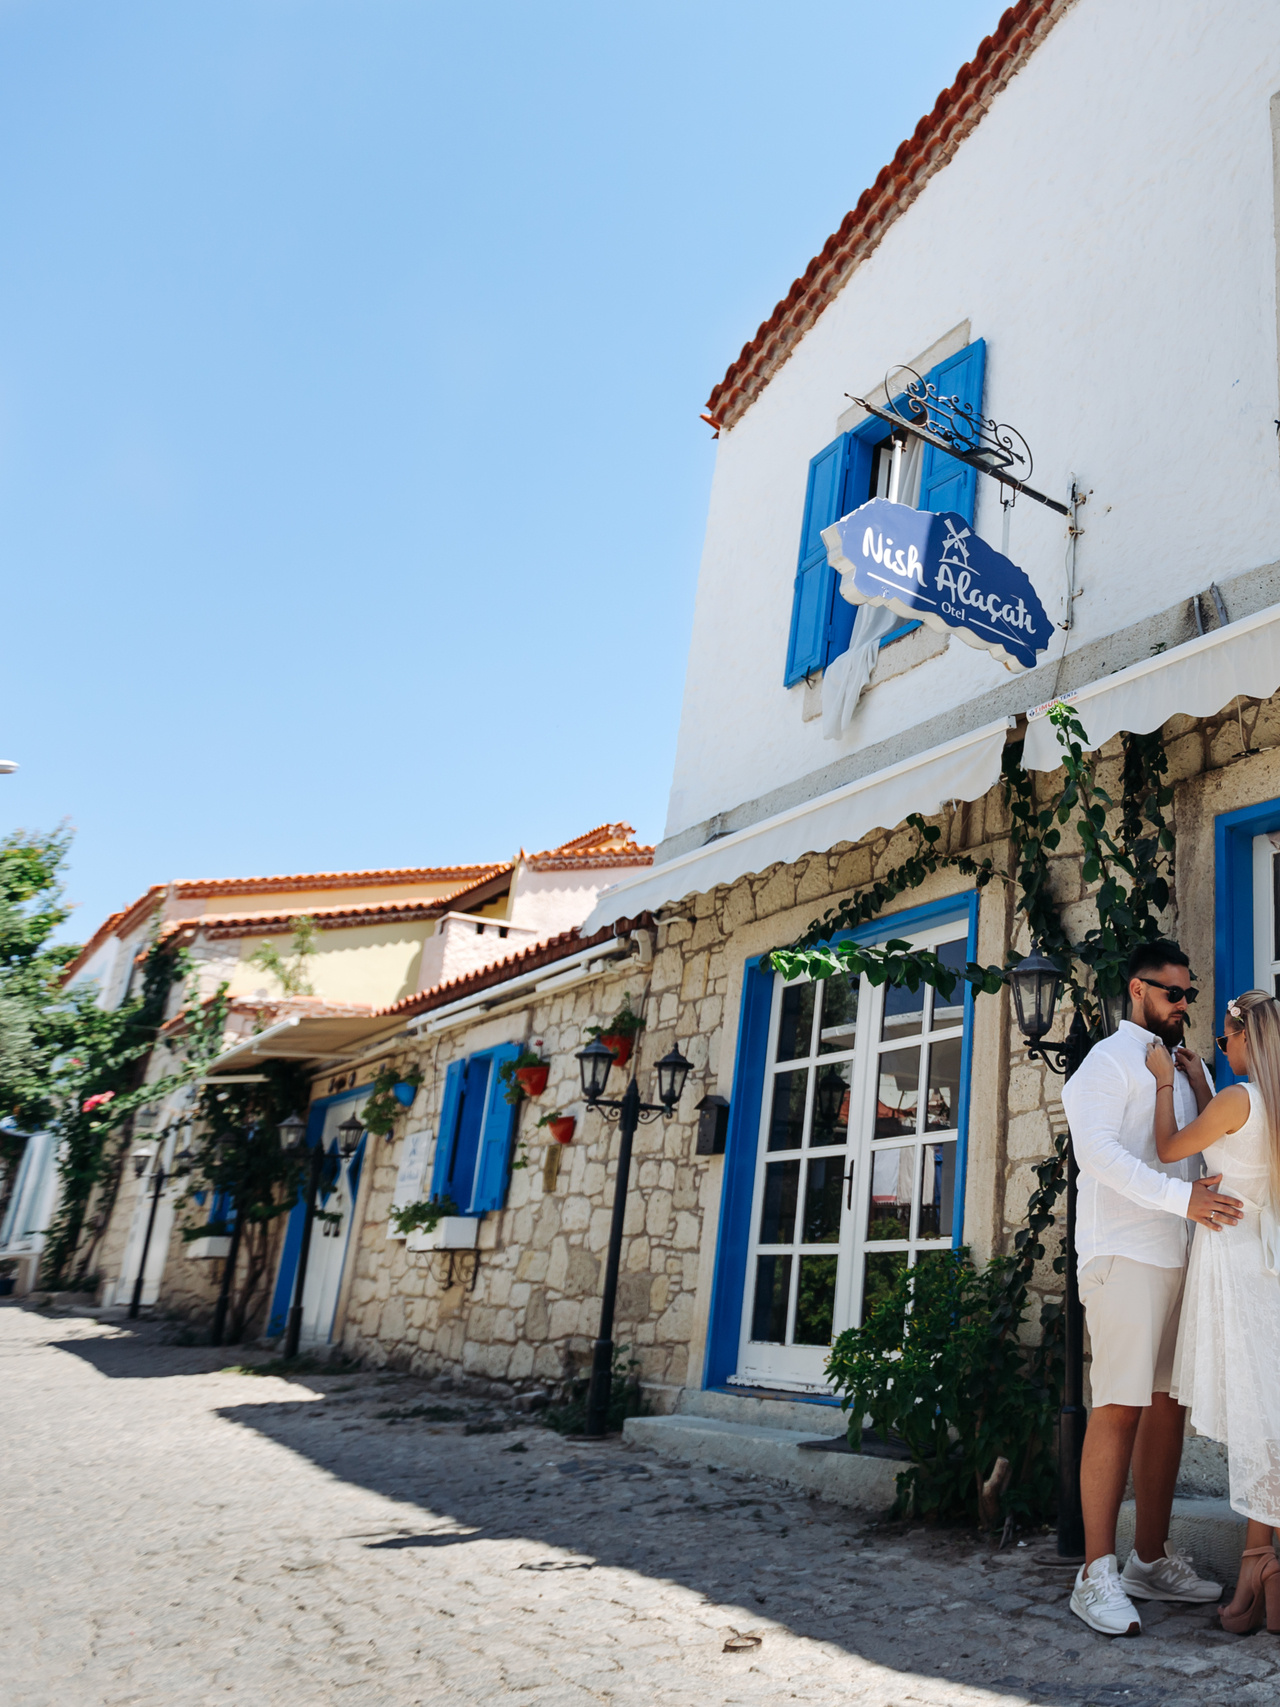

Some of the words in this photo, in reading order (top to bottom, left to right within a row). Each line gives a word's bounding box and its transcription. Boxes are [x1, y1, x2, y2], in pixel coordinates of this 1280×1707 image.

[862, 527, 927, 587] Nish
[934, 564, 1036, 634] Alaçatı
[941, 602, 965, 620] Otel
